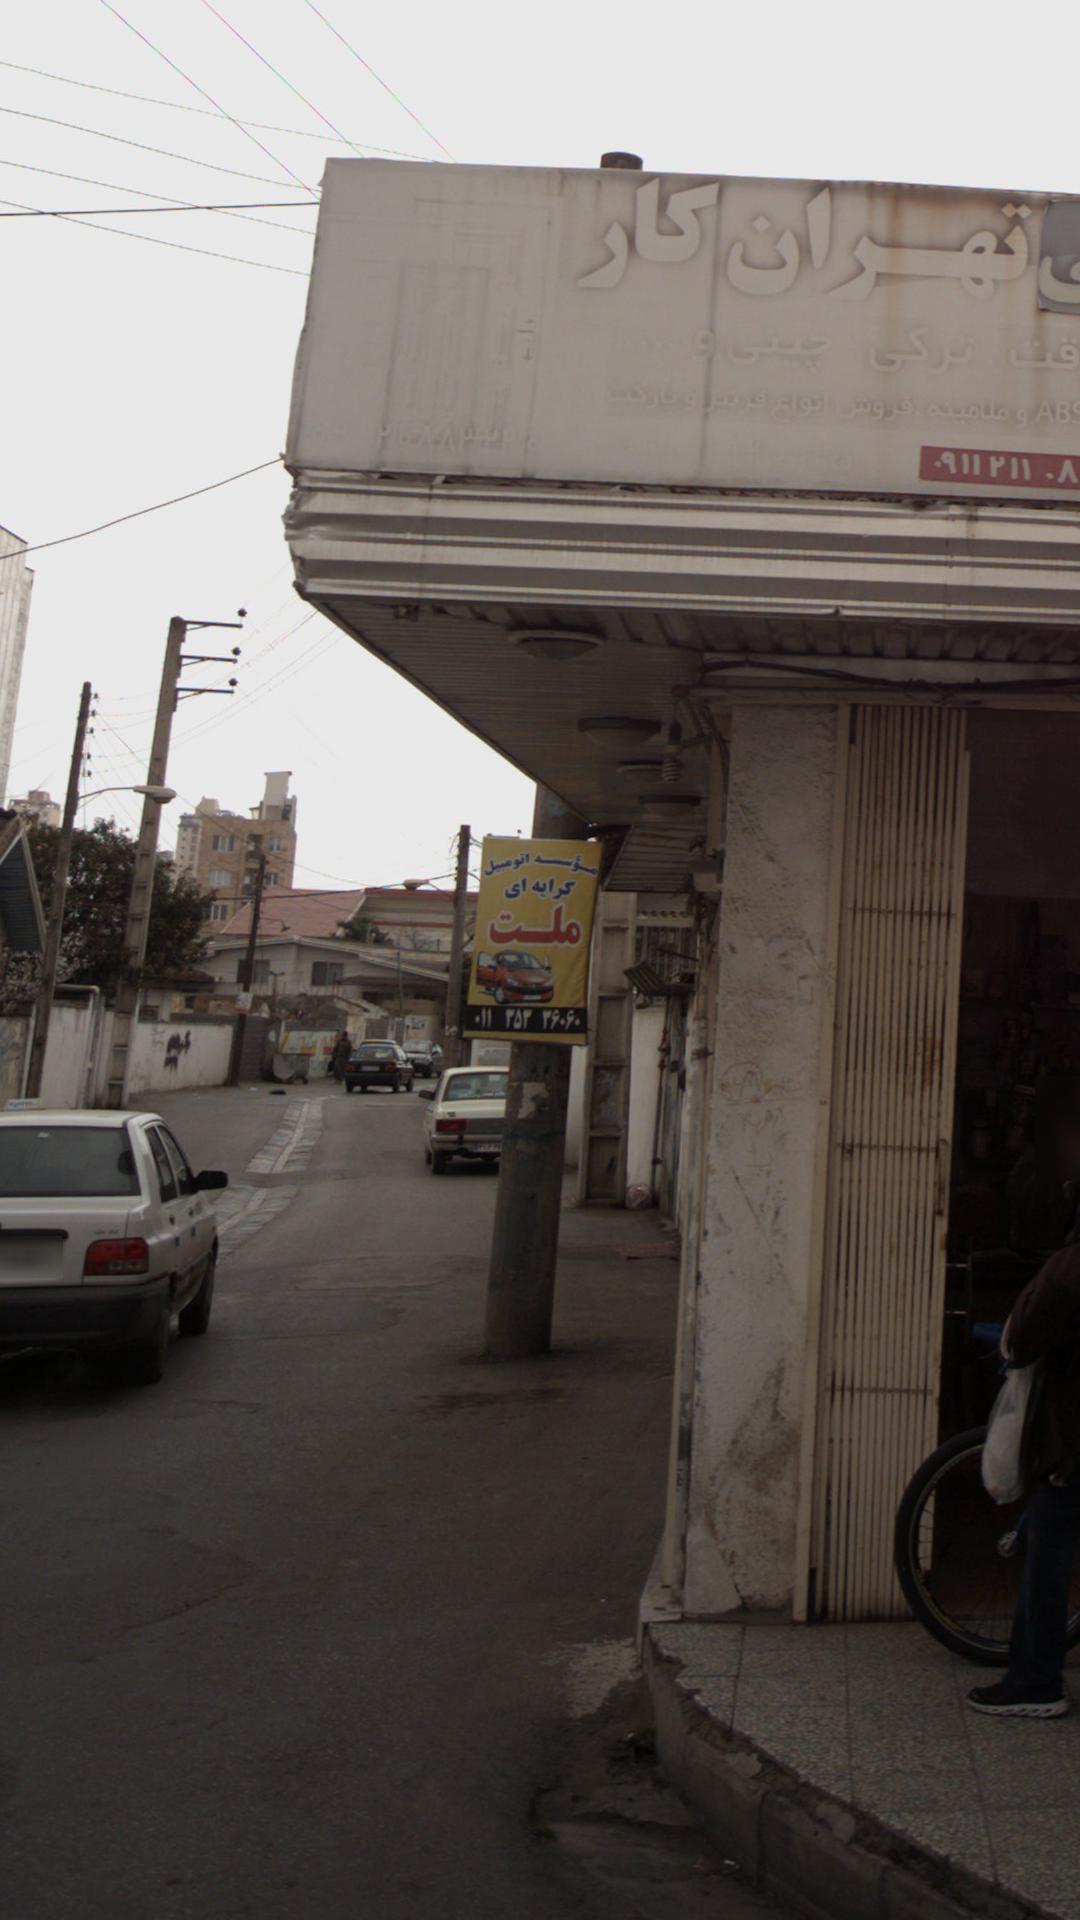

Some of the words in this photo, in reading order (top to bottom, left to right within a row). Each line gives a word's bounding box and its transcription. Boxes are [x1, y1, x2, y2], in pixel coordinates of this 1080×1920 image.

[577, 178, 719, 288] کار
[726, 188, 1032, 302] تهران
[870, 327, 974, 374] ترکی
[484, 852, 530, 876] اتومبیل
[505, 877, 527, 899] ای
[531, 878, 577, 900] کرایه
[490, 904, 581, 944] ملت
[474, 1008, 492, 1029] ۰۱۱
